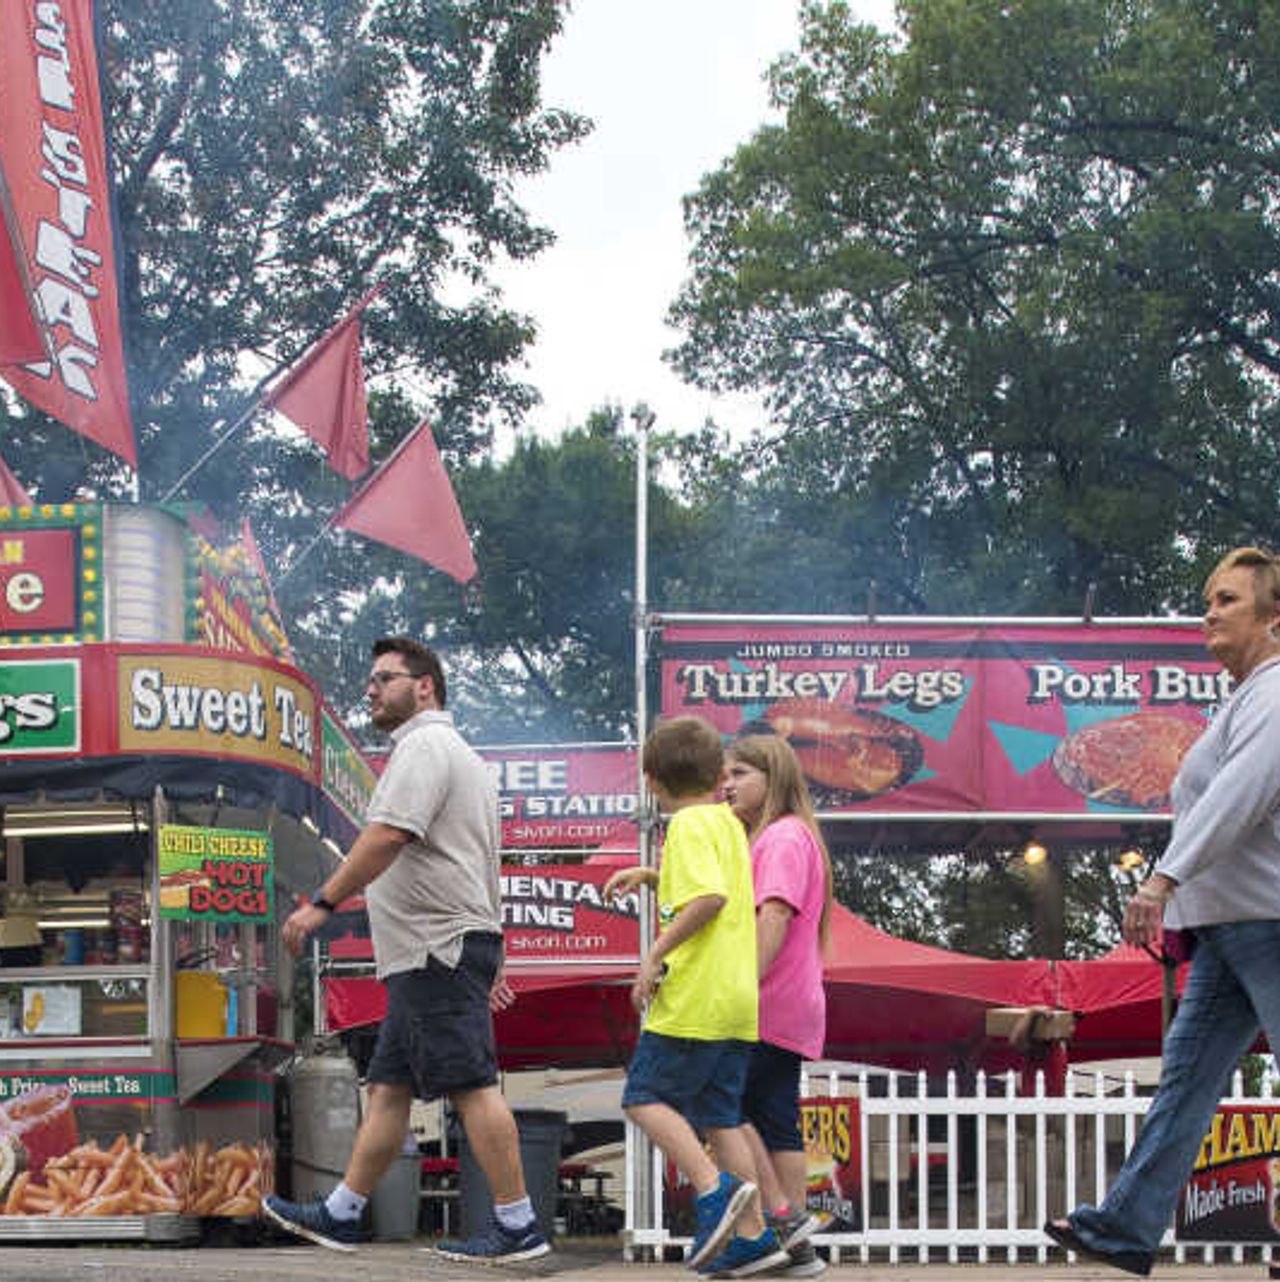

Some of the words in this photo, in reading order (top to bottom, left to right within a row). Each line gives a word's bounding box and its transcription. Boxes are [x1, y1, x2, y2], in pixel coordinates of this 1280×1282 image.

[683, 664, 849, 699] Turkey
[862, 665, 963, 706] Legs
[1033, 663, 1142, 698] Pork
[1154, 665, 1235, 700] But
[132, 667, 268, 738] Sweet
[274, 685, 314, 760] Tea
[526, 794, 639, 817] STATIO
[203, 860, 269, 887] HOT
[115, 1075, 141, 1093] Tea
